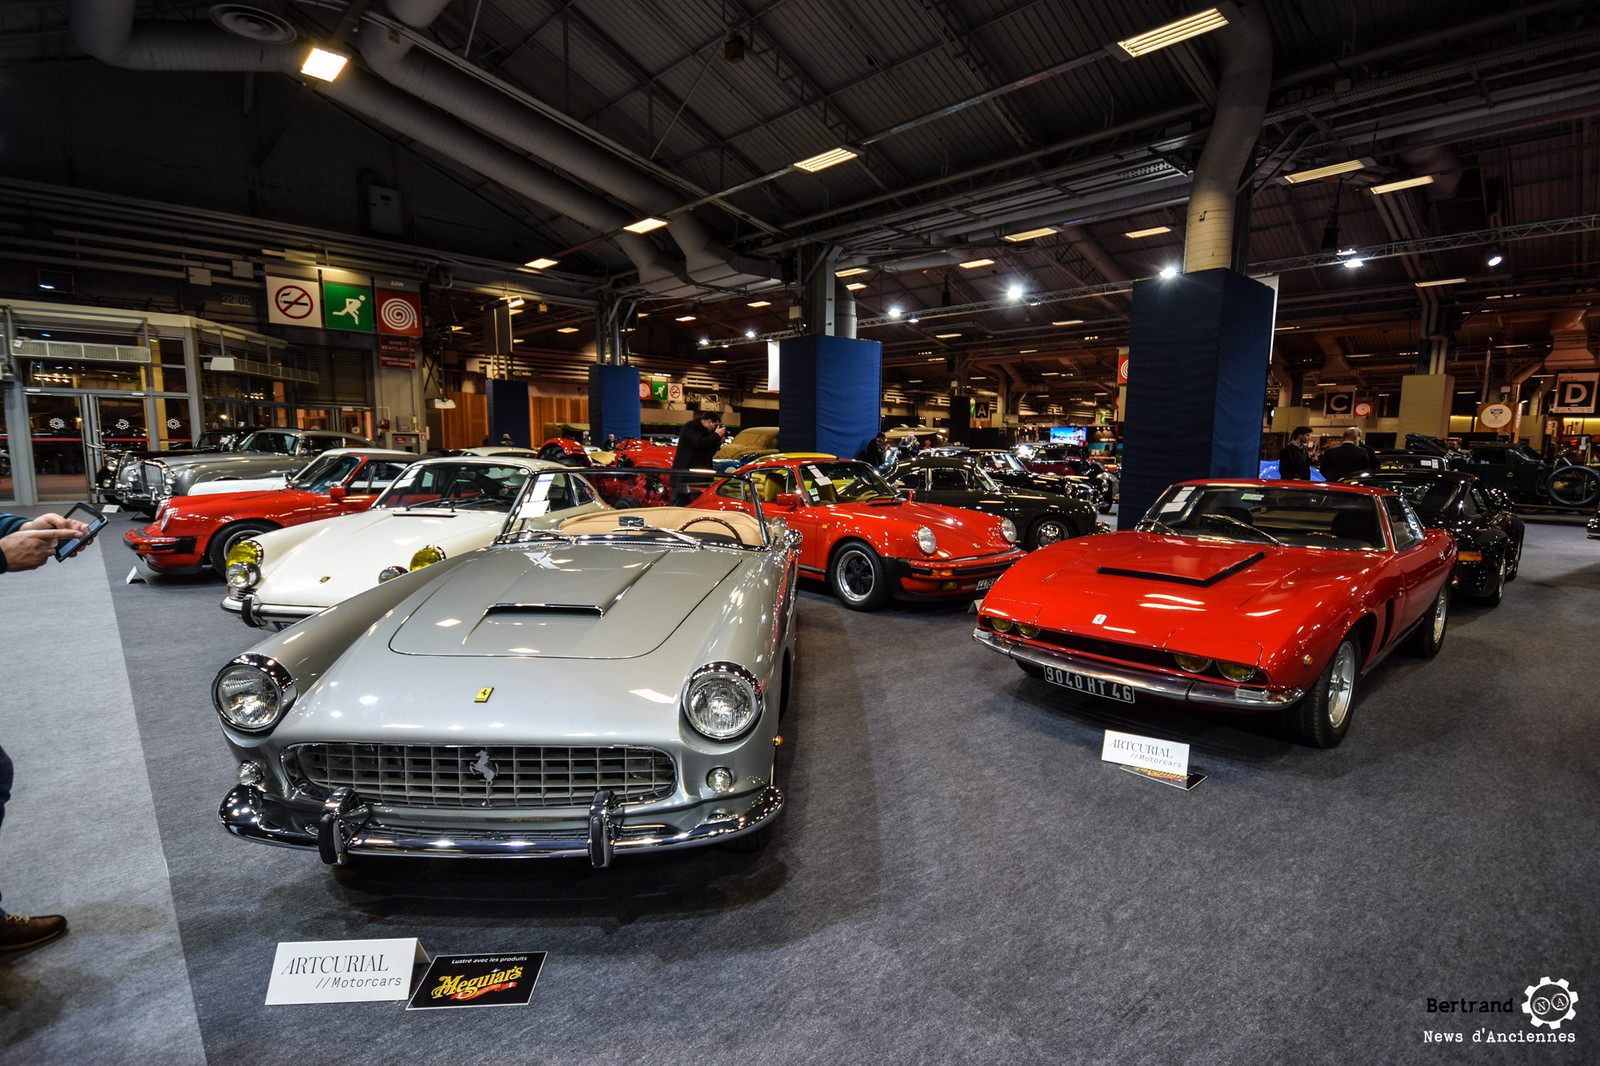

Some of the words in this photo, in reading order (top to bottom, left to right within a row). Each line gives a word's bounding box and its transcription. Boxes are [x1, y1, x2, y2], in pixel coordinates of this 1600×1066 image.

[1329, 393, 1350, 412] C
[1564, 383, 1588, 404] D
[976, 403, 988, 417] A
[1046, 667, 1083, 689] 9040
[1087, 677, 1106, 695] HT
[1112, 683, 1132, 701] 46
[1108, 739, 1173, 759] ARTCURIAL
[280, 954, 390, 976] ARTCURIAL
[499, 955, 528, 963] produits
[431, 965, 524, 999] Meguiar's
